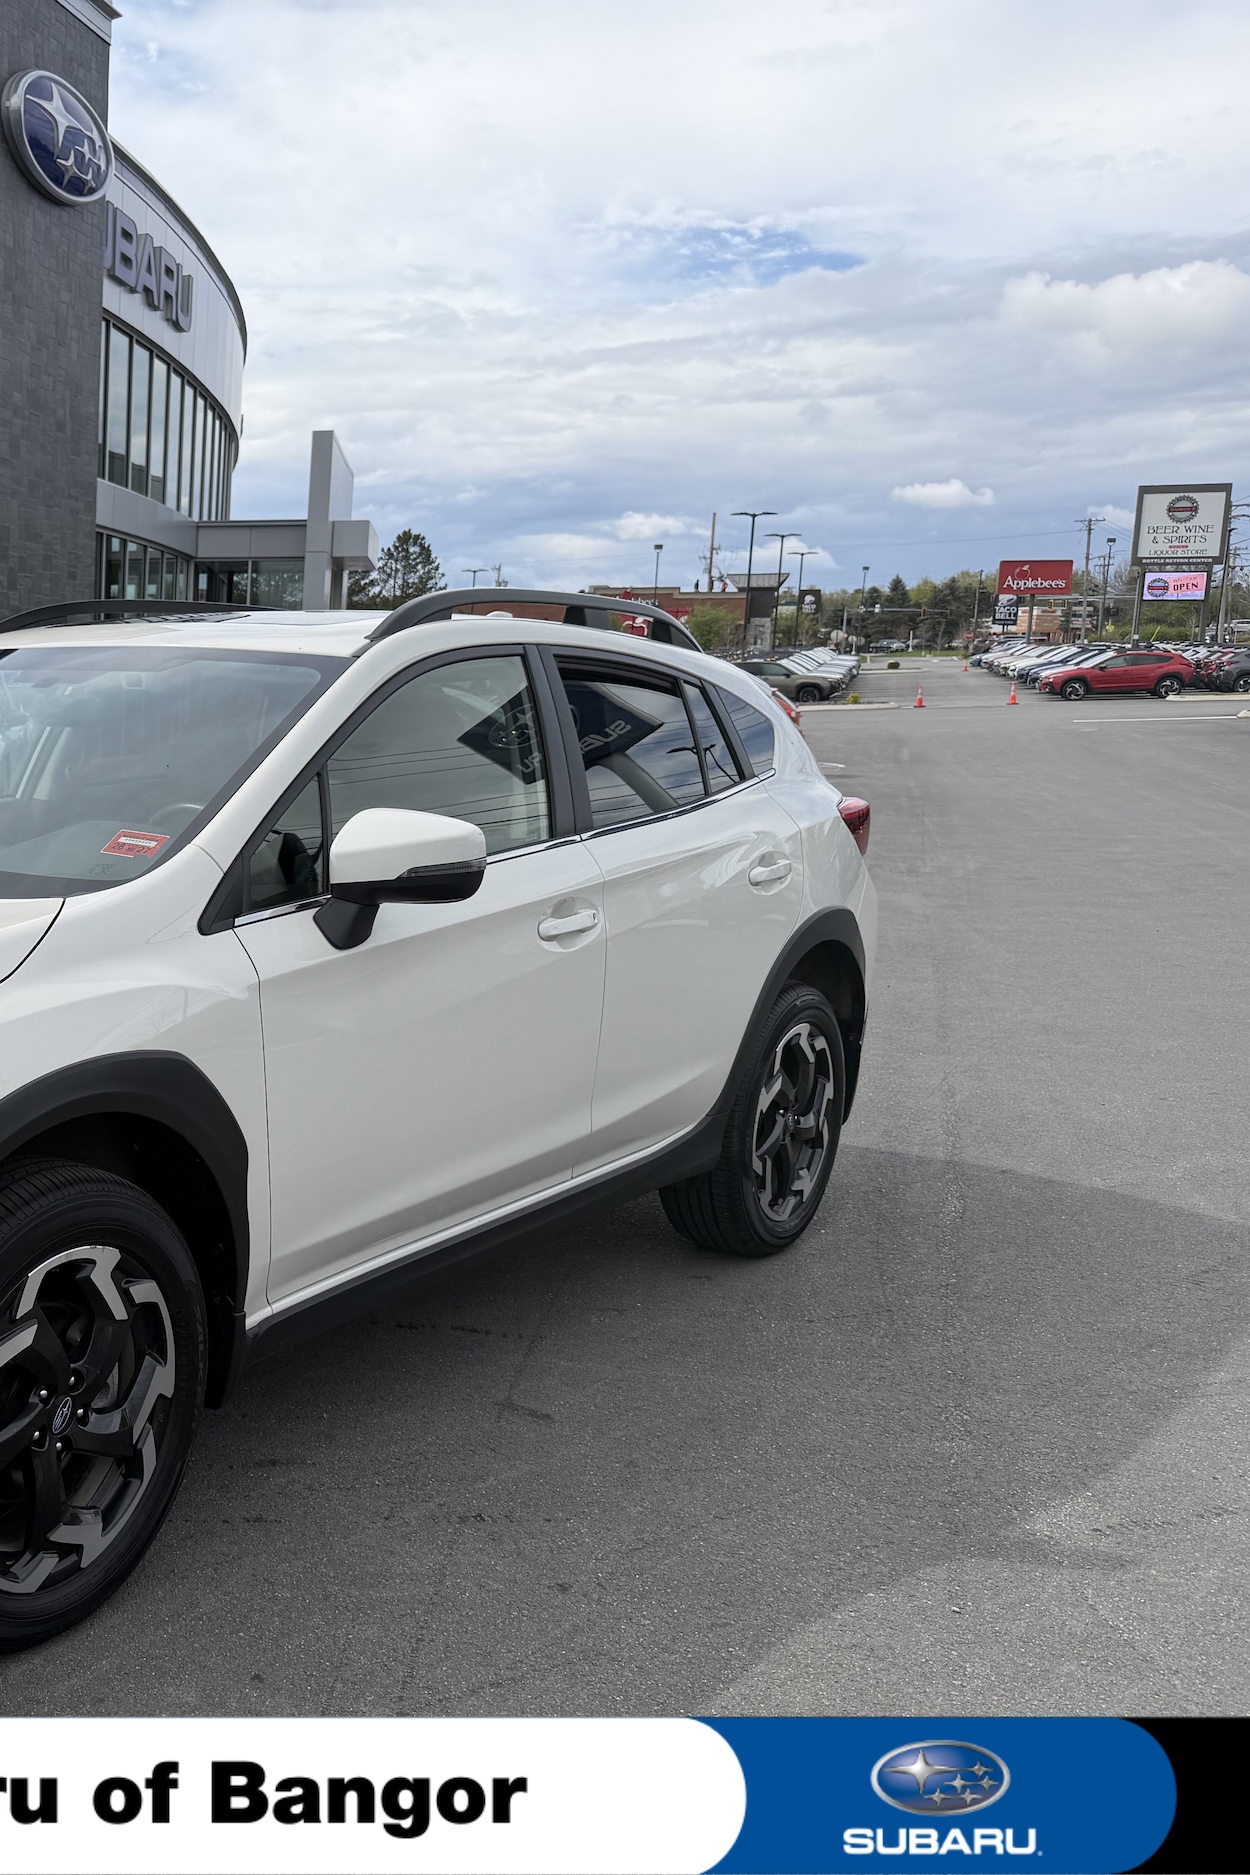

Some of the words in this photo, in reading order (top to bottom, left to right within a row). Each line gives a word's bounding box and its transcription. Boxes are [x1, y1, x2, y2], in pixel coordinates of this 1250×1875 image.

[1147, 526, 1180, 534] BEER
[1184, 525, 1214, 533] WINE
[1152, 536, 1159, 544] &
[1163, 535, 1207, 544] SPIRITS
[1003, 575, 1066, 591] Applebee's
[1173, 582, 1199, 591] OPEN
[995, 612, 1016, 620] BELL
[136, 846, 151, 854] 27
